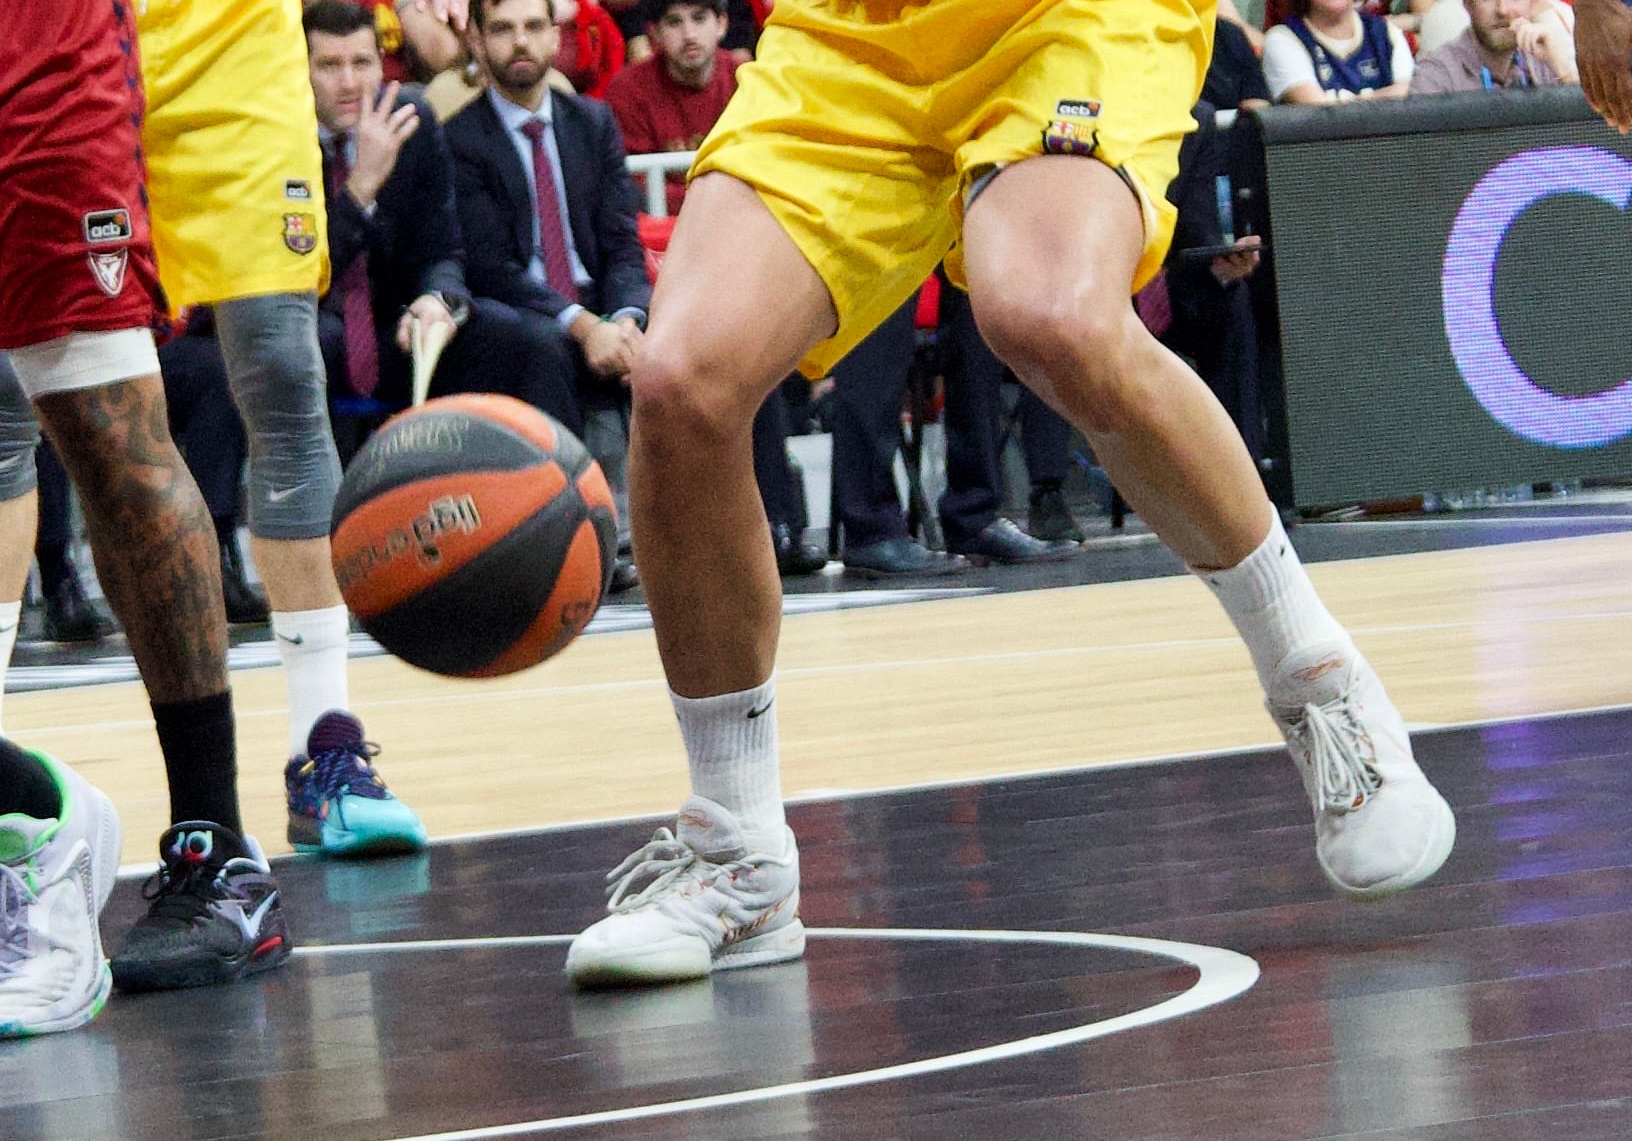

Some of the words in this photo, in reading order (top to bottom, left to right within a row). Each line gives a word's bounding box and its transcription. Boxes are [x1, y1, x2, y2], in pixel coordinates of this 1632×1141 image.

[1059, 104, 1090, 116] acb
[287, 186, 308, 198] acb
[90, 223, 121, 238] acb
